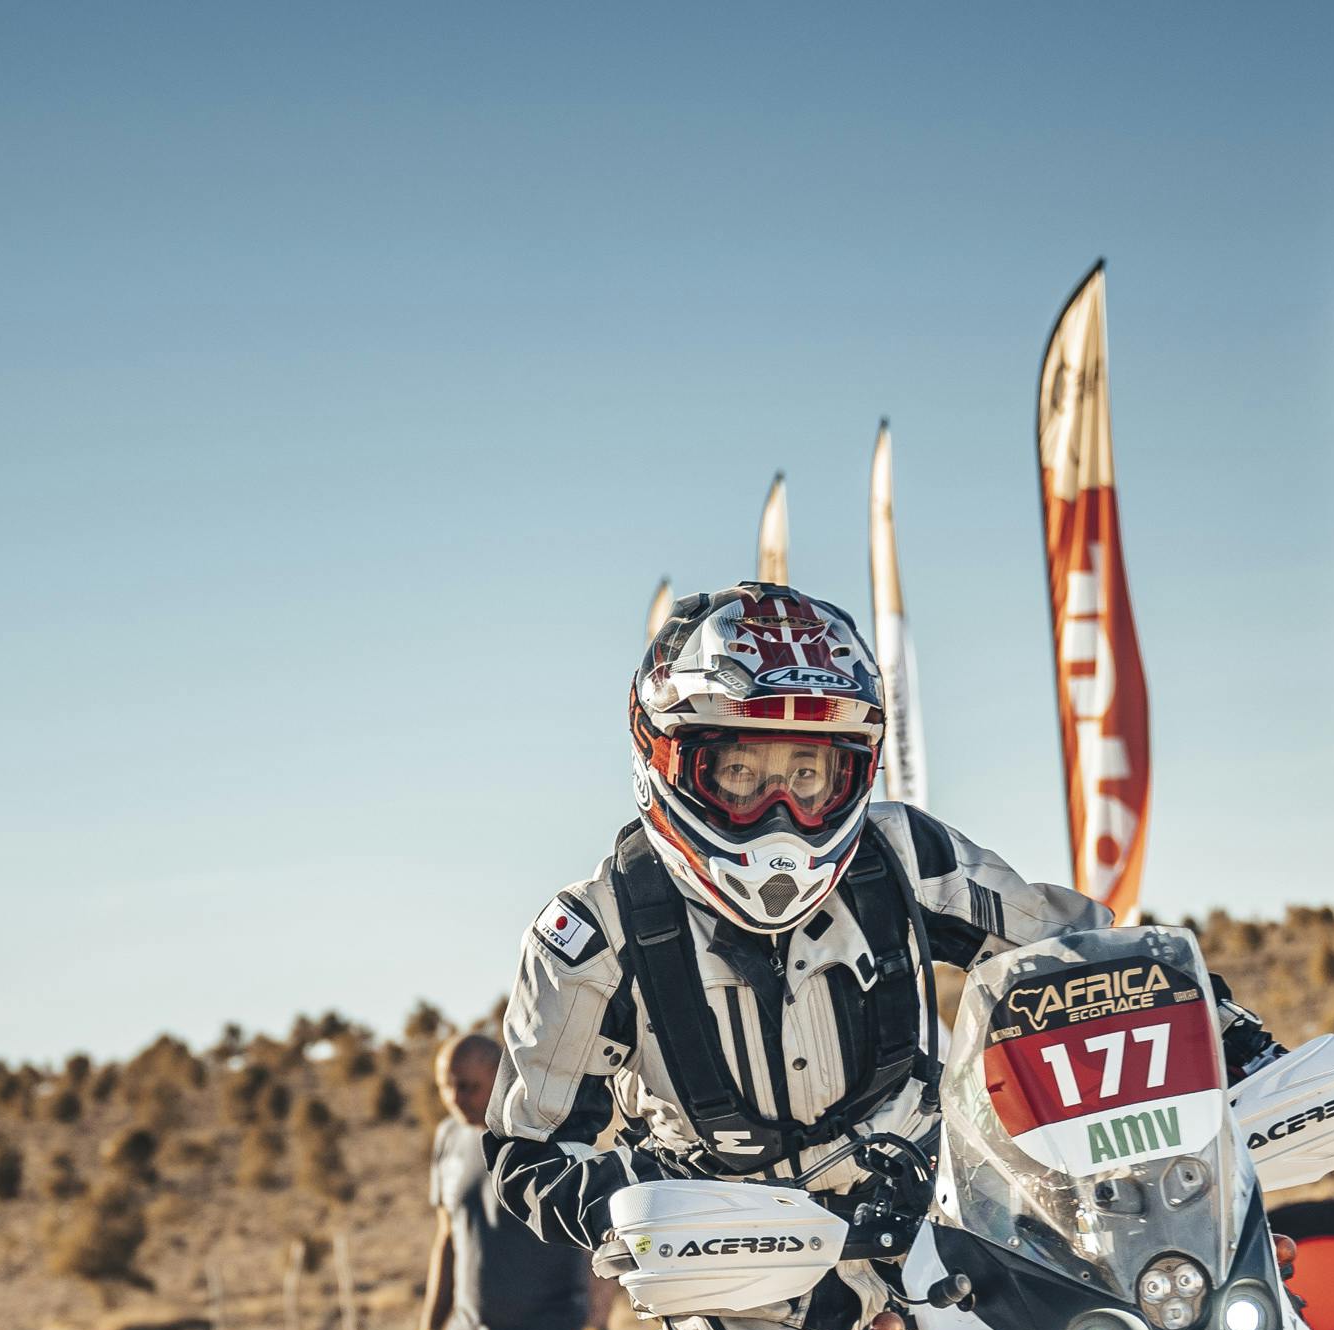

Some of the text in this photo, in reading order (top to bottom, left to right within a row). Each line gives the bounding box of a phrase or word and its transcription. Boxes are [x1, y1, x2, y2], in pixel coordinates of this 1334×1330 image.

[768, 669, 849, 686] Arai
[771, 857, 794, 868] Arai
[542, 926, 566, 948] JAPAN
[1033, 963, 1170, 1022] AFRICA
[1040, 1023, 1171, 1107] 177
